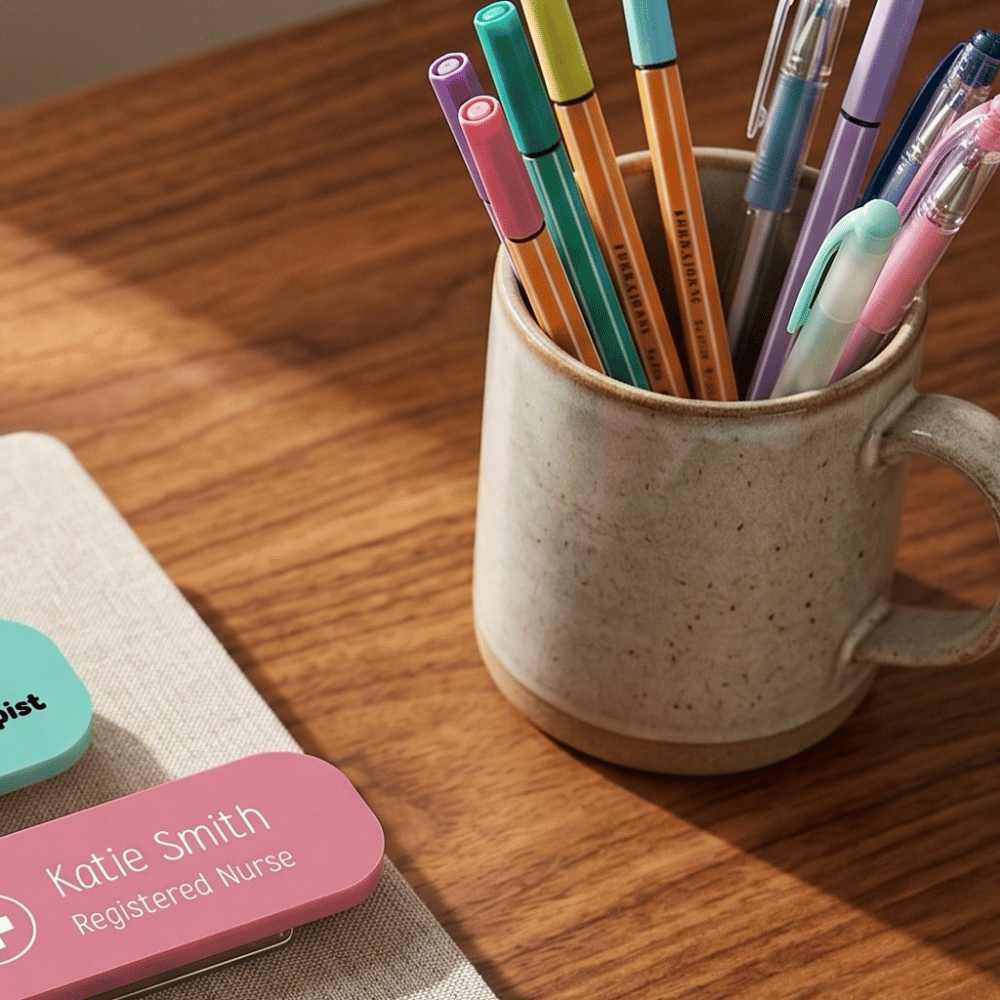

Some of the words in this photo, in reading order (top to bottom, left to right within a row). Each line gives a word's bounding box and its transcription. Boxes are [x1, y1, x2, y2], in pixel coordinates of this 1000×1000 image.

[46, 848, 148, 897] Katie
[154, 805, 270, 860] Smith
[72, 873, 213, 935] Registered
[217, 850, 295, 887] Nurse
